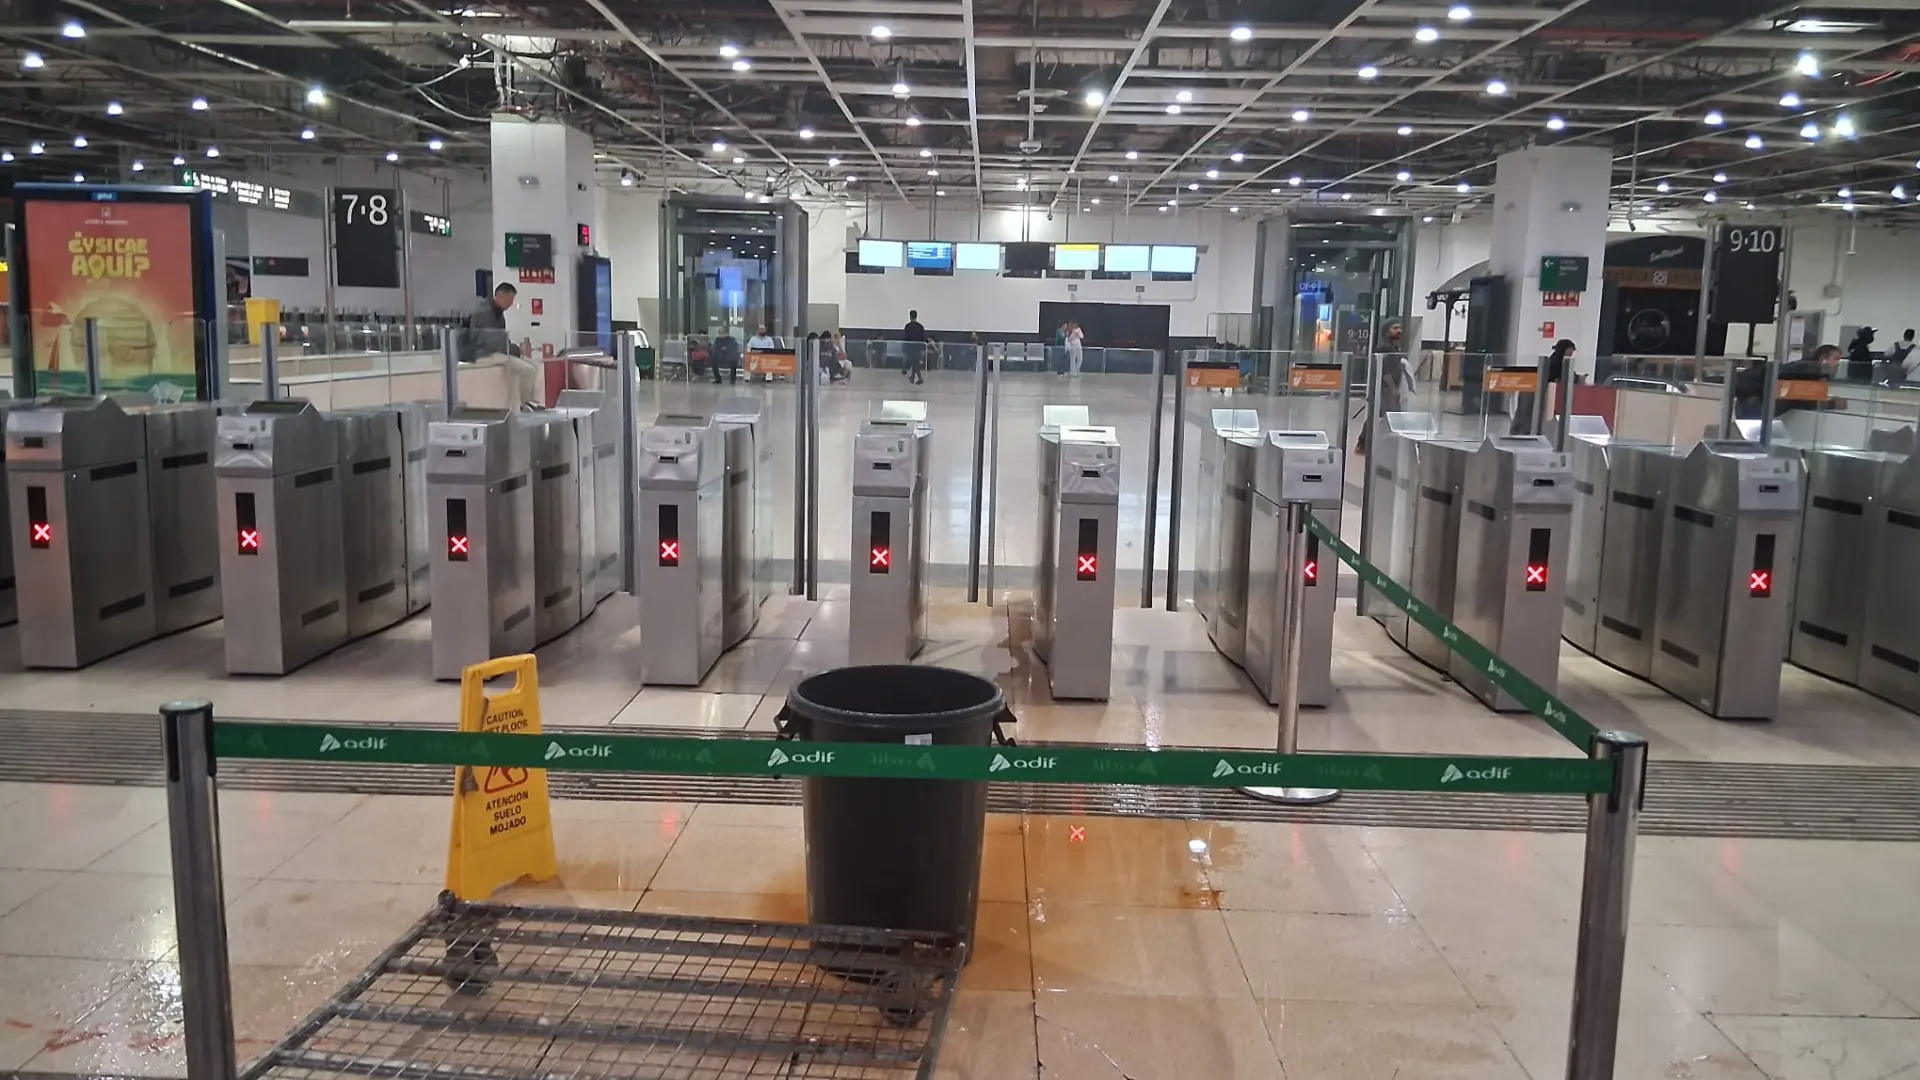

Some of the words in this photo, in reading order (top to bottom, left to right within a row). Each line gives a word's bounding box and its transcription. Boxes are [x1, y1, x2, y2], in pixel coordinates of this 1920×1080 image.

[486, 708, 524, 725] CAUTION
[501, 719, 529, 733] FLOOR
[344, 737, 389, 751] adif
[568, 744, 614, 758] adif
[791, 750, 836, 764] adif
[1013, 756, 1058, 770] adif
[1237, 761, 1283, 776] adif
[1465, 766, 1513, 781] adif
[485, 791, 529, 812] ATENCION
[493, 805, 522, 821] SUELO
[489, 815, 527, 836] MOJADO
